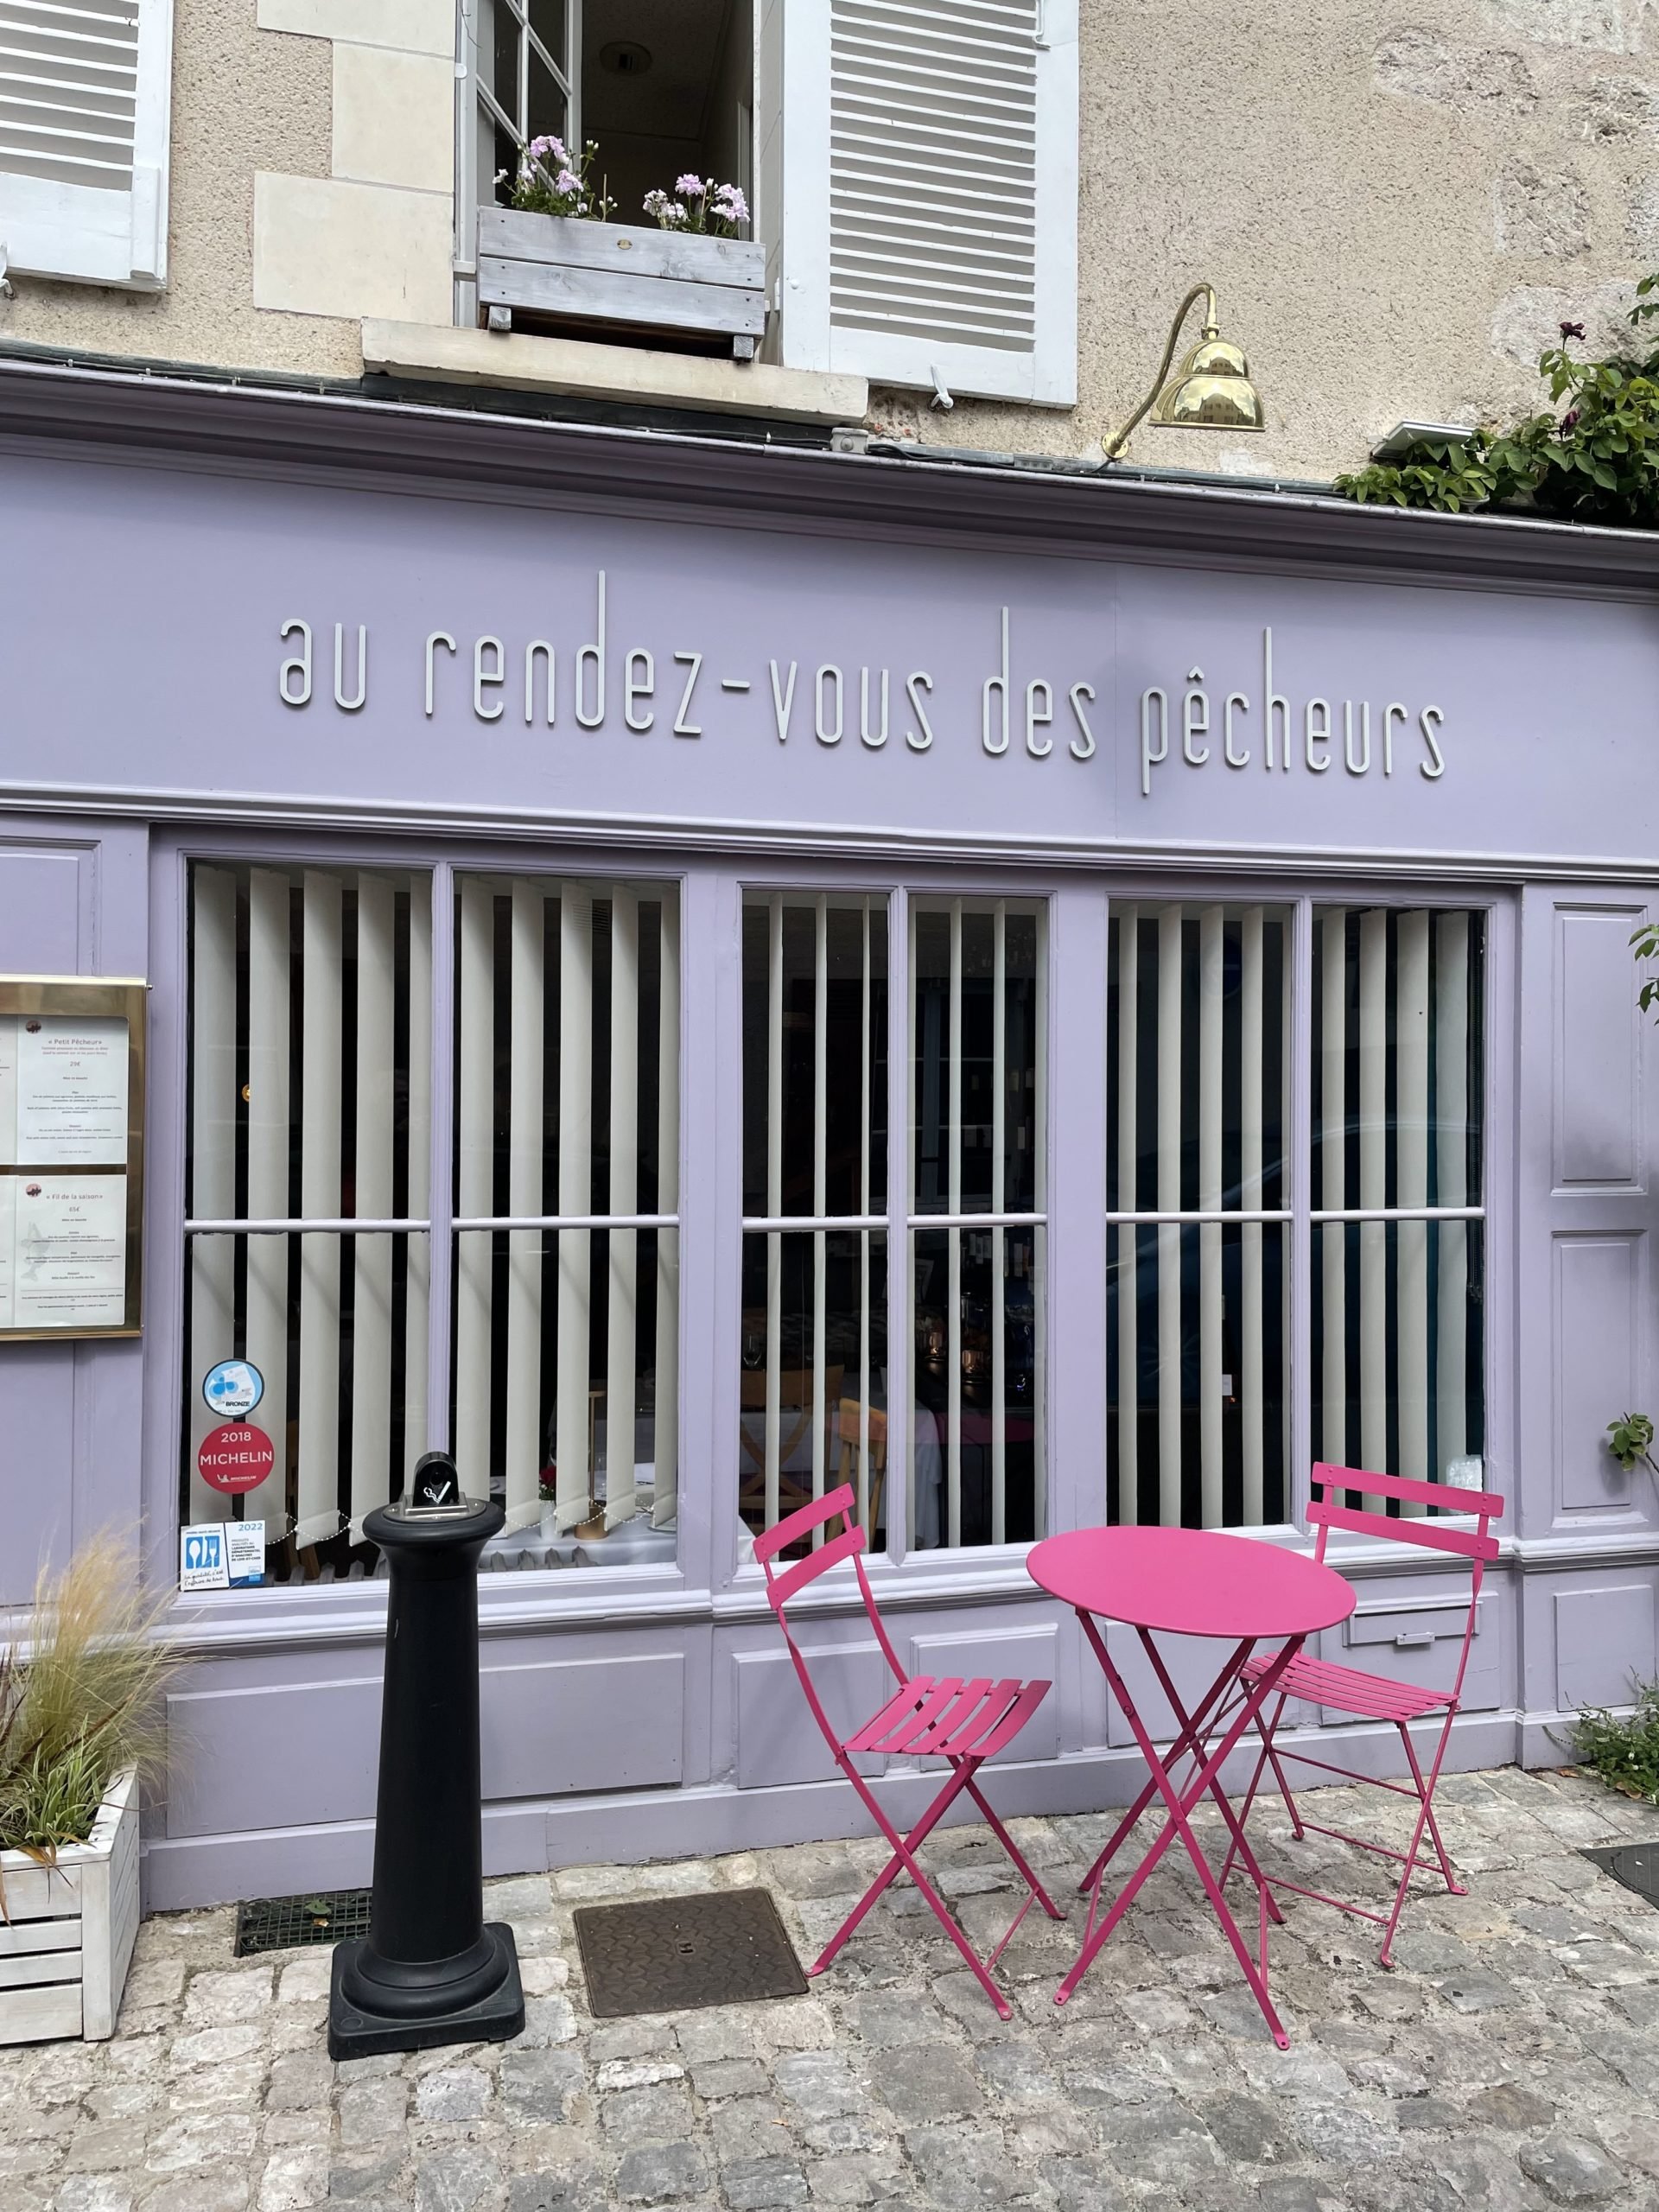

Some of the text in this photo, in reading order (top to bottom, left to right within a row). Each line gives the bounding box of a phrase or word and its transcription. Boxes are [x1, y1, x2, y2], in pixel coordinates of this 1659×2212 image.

[280, 569, 1446, 796] au rendez-vous des pêcheurs
[220, 1431, 251, 1443] 2018
[200, 1451, 272, 1466] MICHELIN
